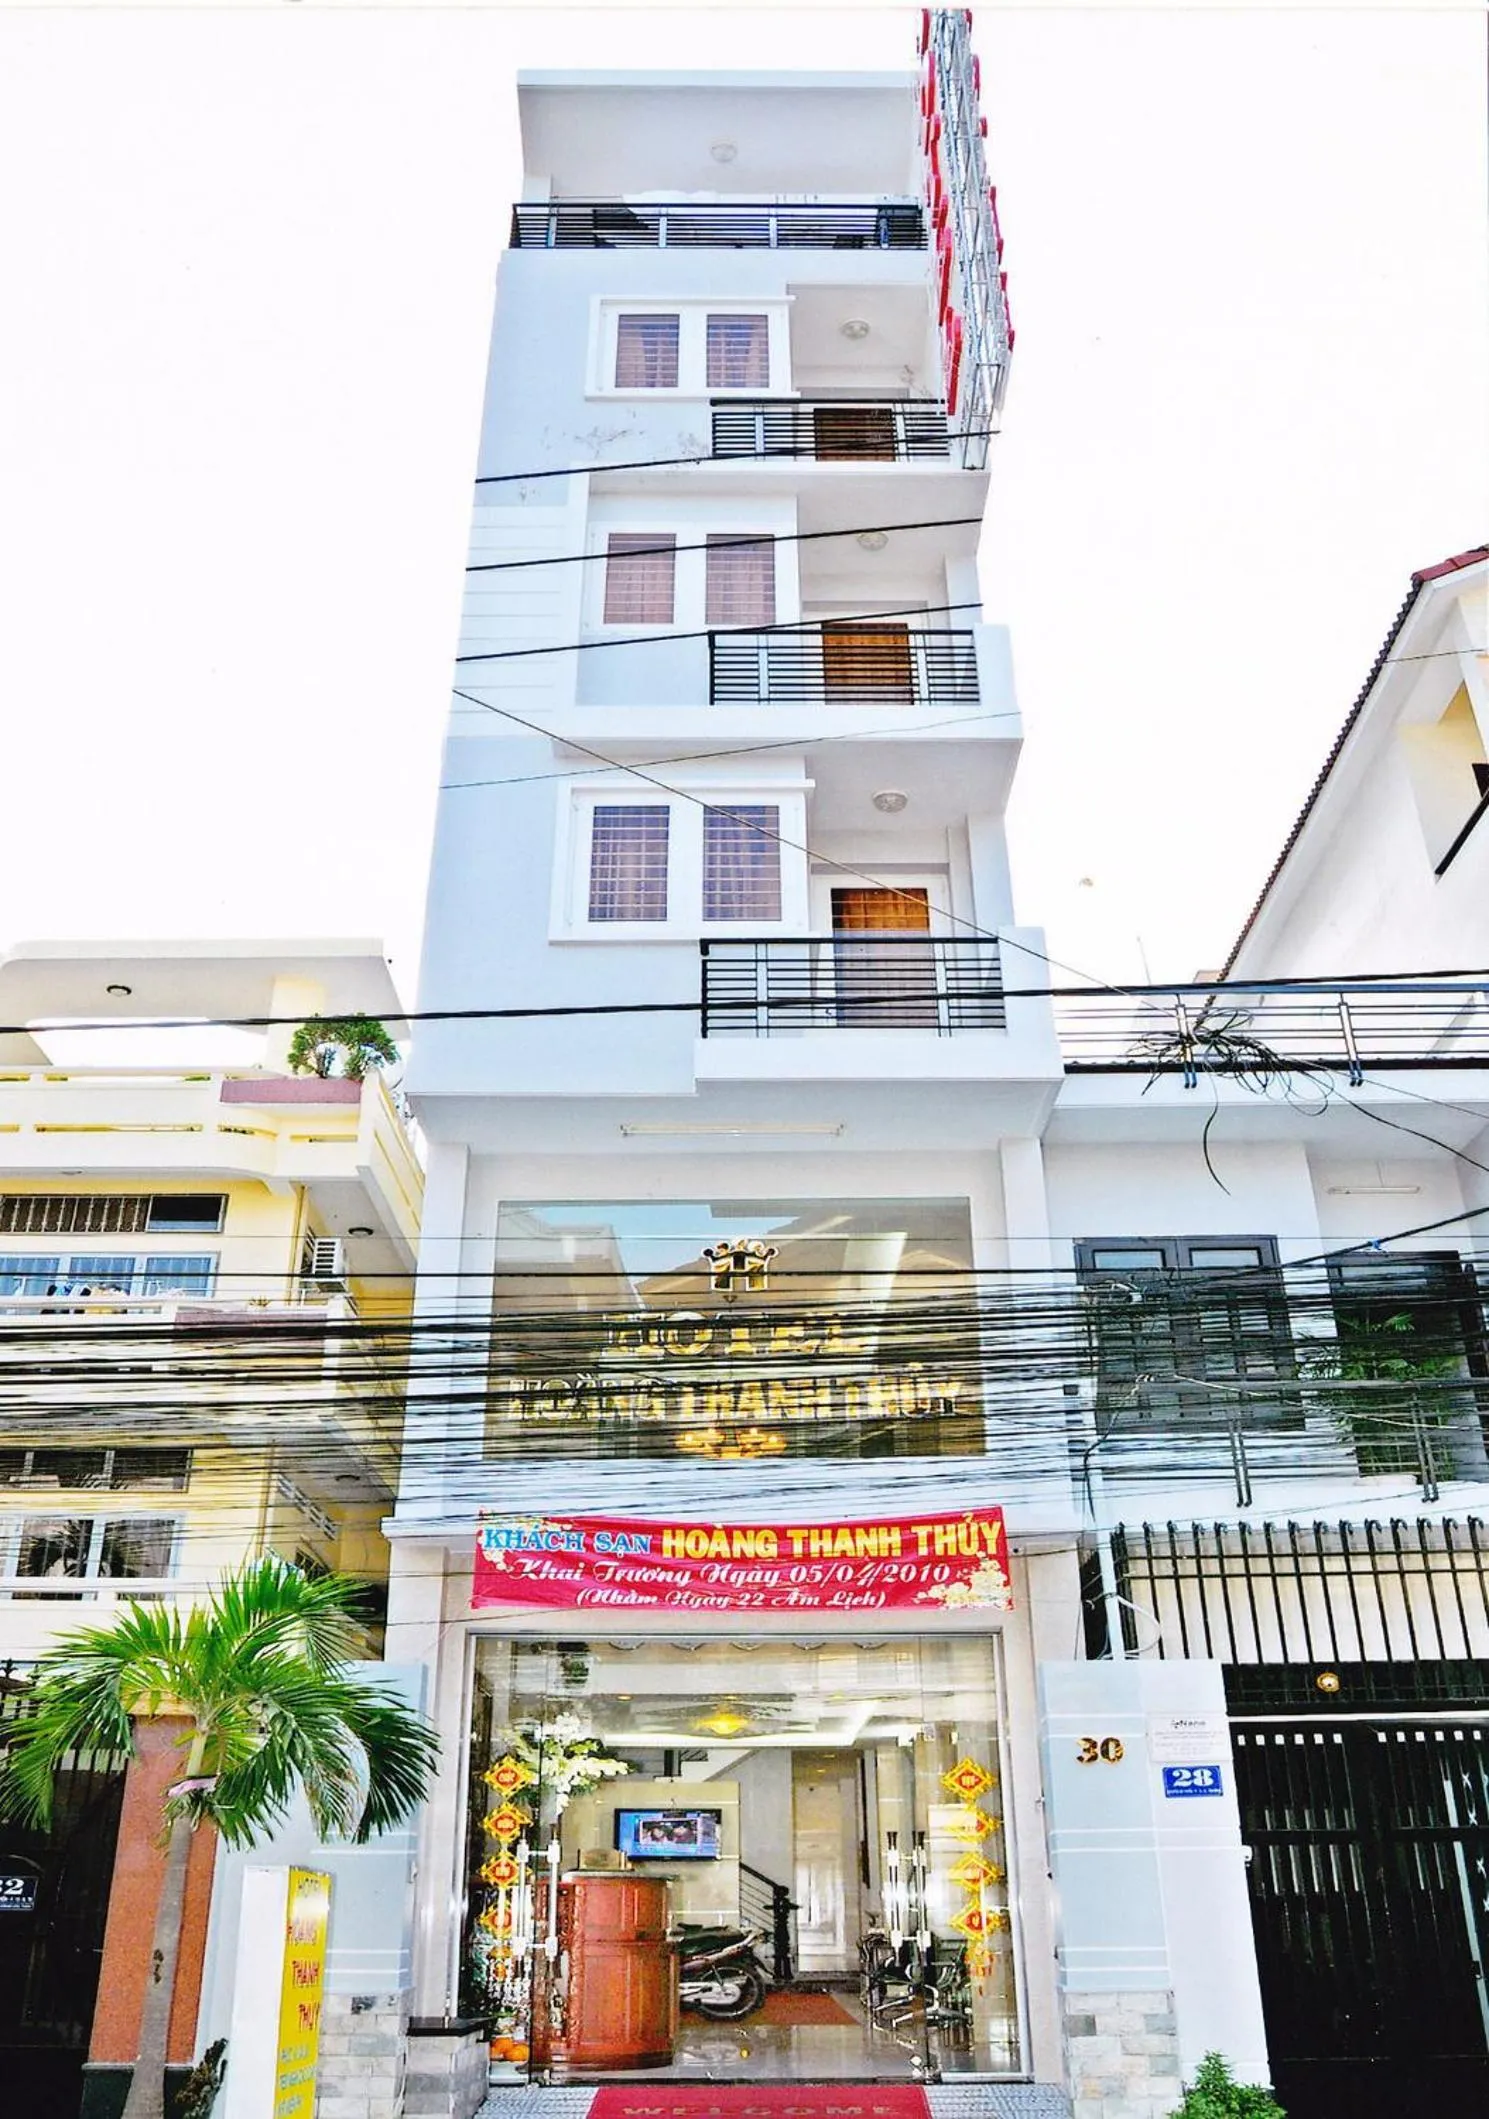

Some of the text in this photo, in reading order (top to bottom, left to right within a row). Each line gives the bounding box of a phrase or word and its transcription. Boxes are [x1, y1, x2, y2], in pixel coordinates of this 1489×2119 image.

[483, 1512, 1002, 1560] KHÁCH SẠN HOÀNG THANH THỦY
[508, 1559, 586, 1581] Khai
[699, 1562, 781, 1588] Ngày
[738, 1592, 765, 1606] 22
[1076, 1737, 1125, 1764] 30
[1171, 1768, 1214, 1787] 28
